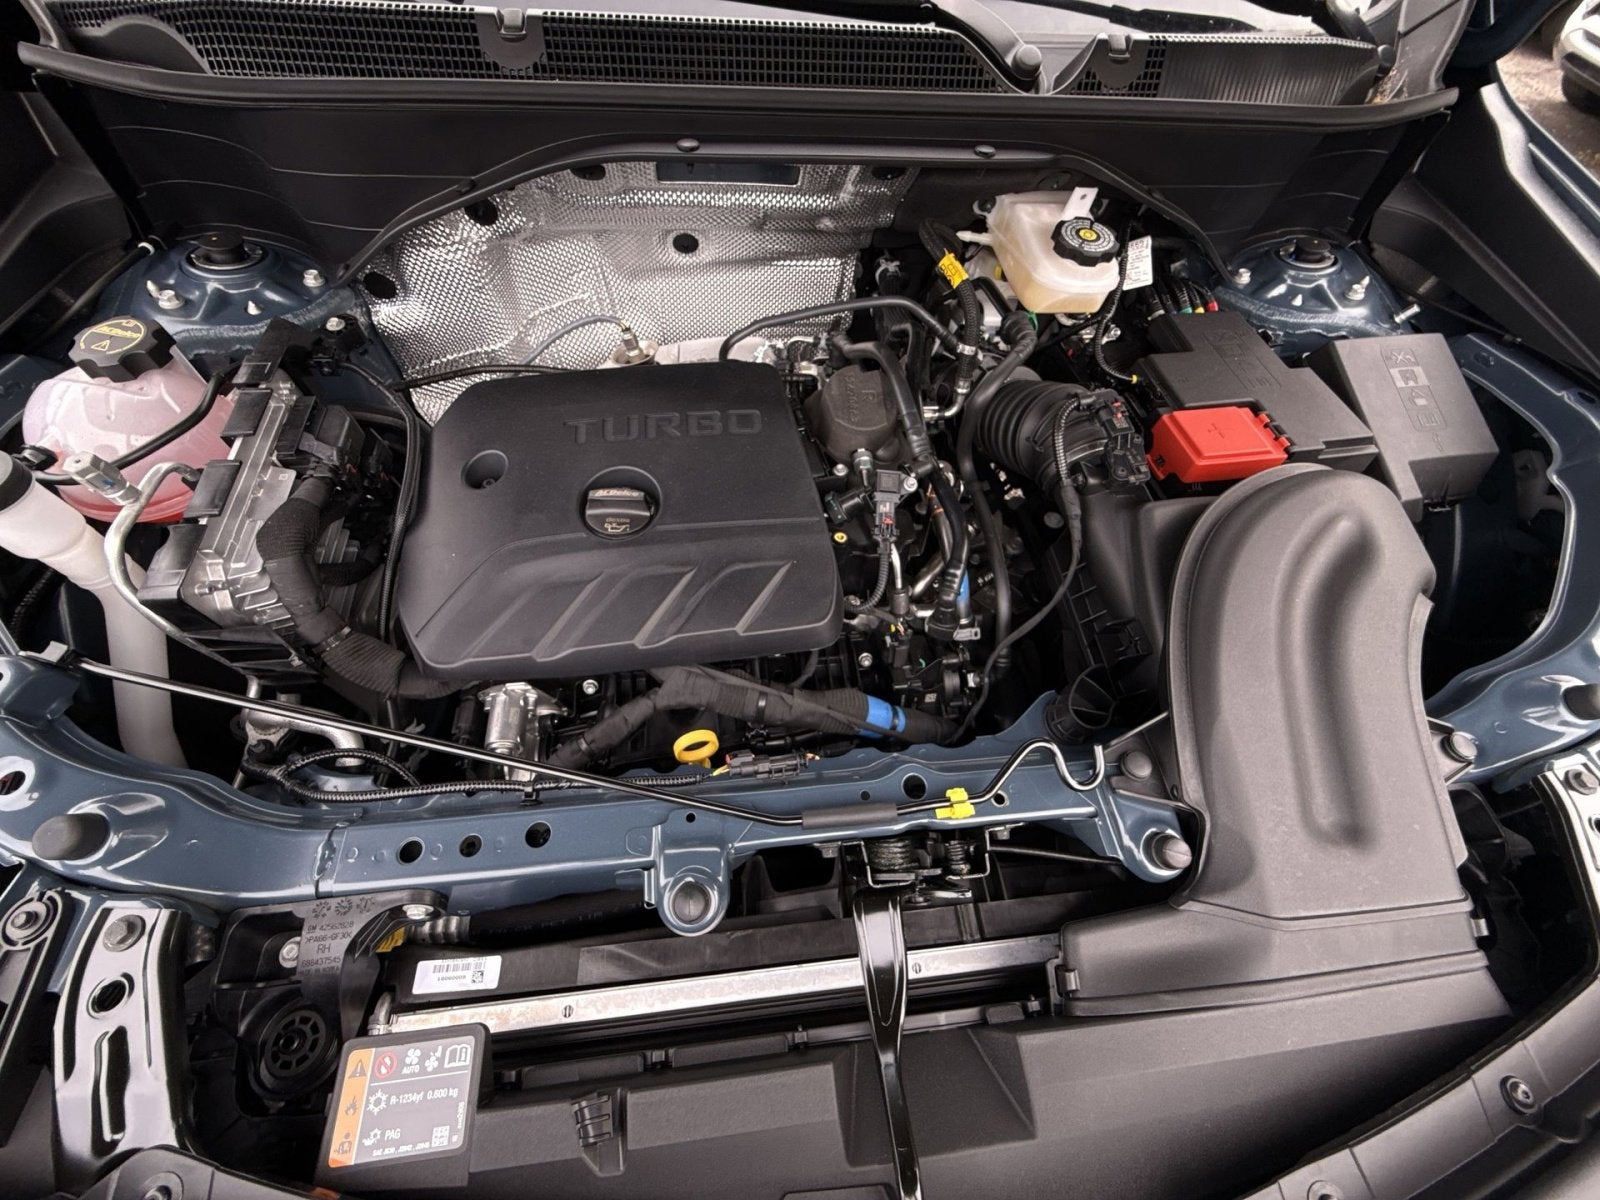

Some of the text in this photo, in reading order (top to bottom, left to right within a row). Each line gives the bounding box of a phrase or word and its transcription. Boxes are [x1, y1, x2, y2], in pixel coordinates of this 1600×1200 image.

[563, 409, 762, 444] TURBO
[594, 489, 639, 497] ACDelco
[316, 943, 331, 954] RH
[402, 1065, 420, 1074] AUTO
[390, 1092, 424, 1105] R-1234yf
[448, 1088, 459, 1098] kg
[384, 1128, 401, 1140] PAG
